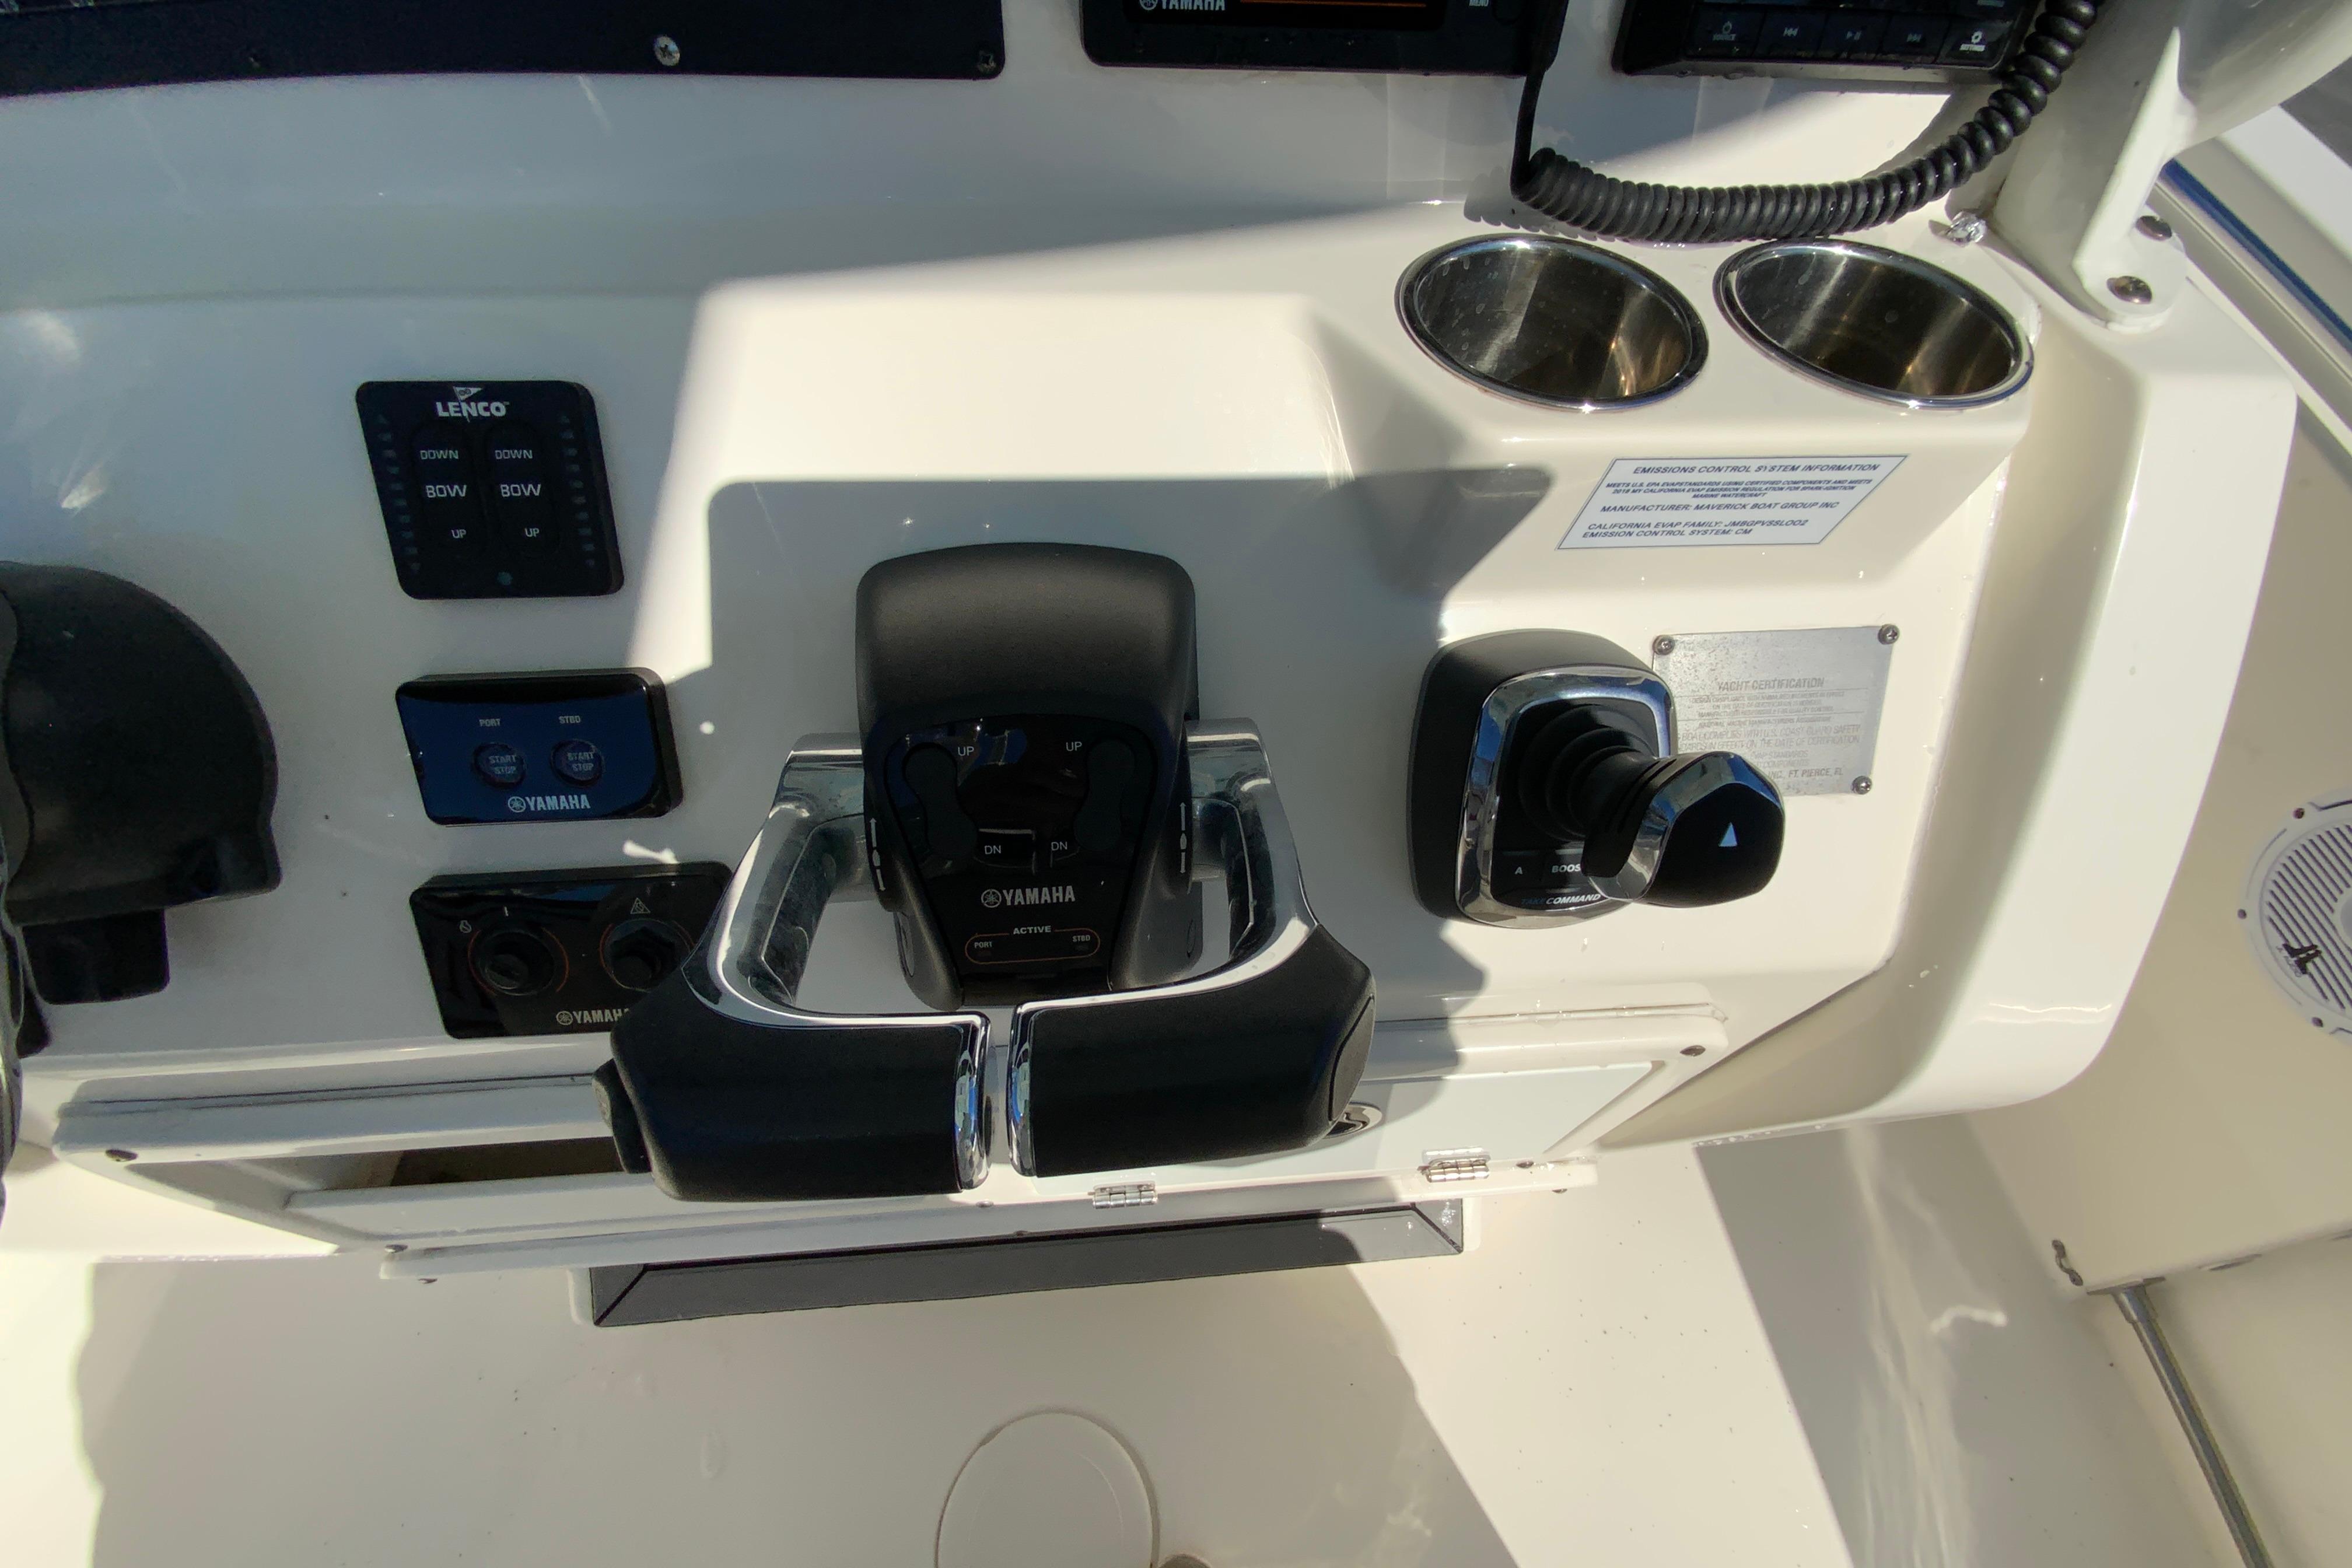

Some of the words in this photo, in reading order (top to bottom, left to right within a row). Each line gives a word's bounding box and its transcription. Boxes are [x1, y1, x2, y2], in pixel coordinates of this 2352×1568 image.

[436, 401, 506, 416] LENCO
[419, 449, 459, 460] DOWN
[495, 449, 533, 460] DOWN
[1633, 466, 1695, 474] EMISSIONS
[425, 485, 467, 498] BOW
[500, 484, 541, 497] BOW
[451, 528, 467, 539] UP
[524, 527, 540, 538] UP
[1718, 681, 1749, 691] YACHT
[1752, 677, 1824, 691] CERTIFICATION
[479, 719, 501, 727] PORT
[558, 715, 581, 724] STBD
[1833, 724, 1860, 734] SAFETY
[957, 746, 974, 757] UP
[1066, 742, 1082, 752] UP
[488, 755, 517, 764] START
[567, 752, 594, 761] START
[494, 766, 516, 775] STOP
[572, 763, 594, 771] STOP
[525, 794, 591, 811] YAMAHA
[985, 845, 1002, 855] DN
[1051, 841, 1068, 851] DN
[1551, 863, 1581, 873] BOOS
[1002, 886, 1076, 906] YAMAHA
[1546, 894, 1601, 905] COMMAND
[1013, 925, 1052, 935] ACTIVE
